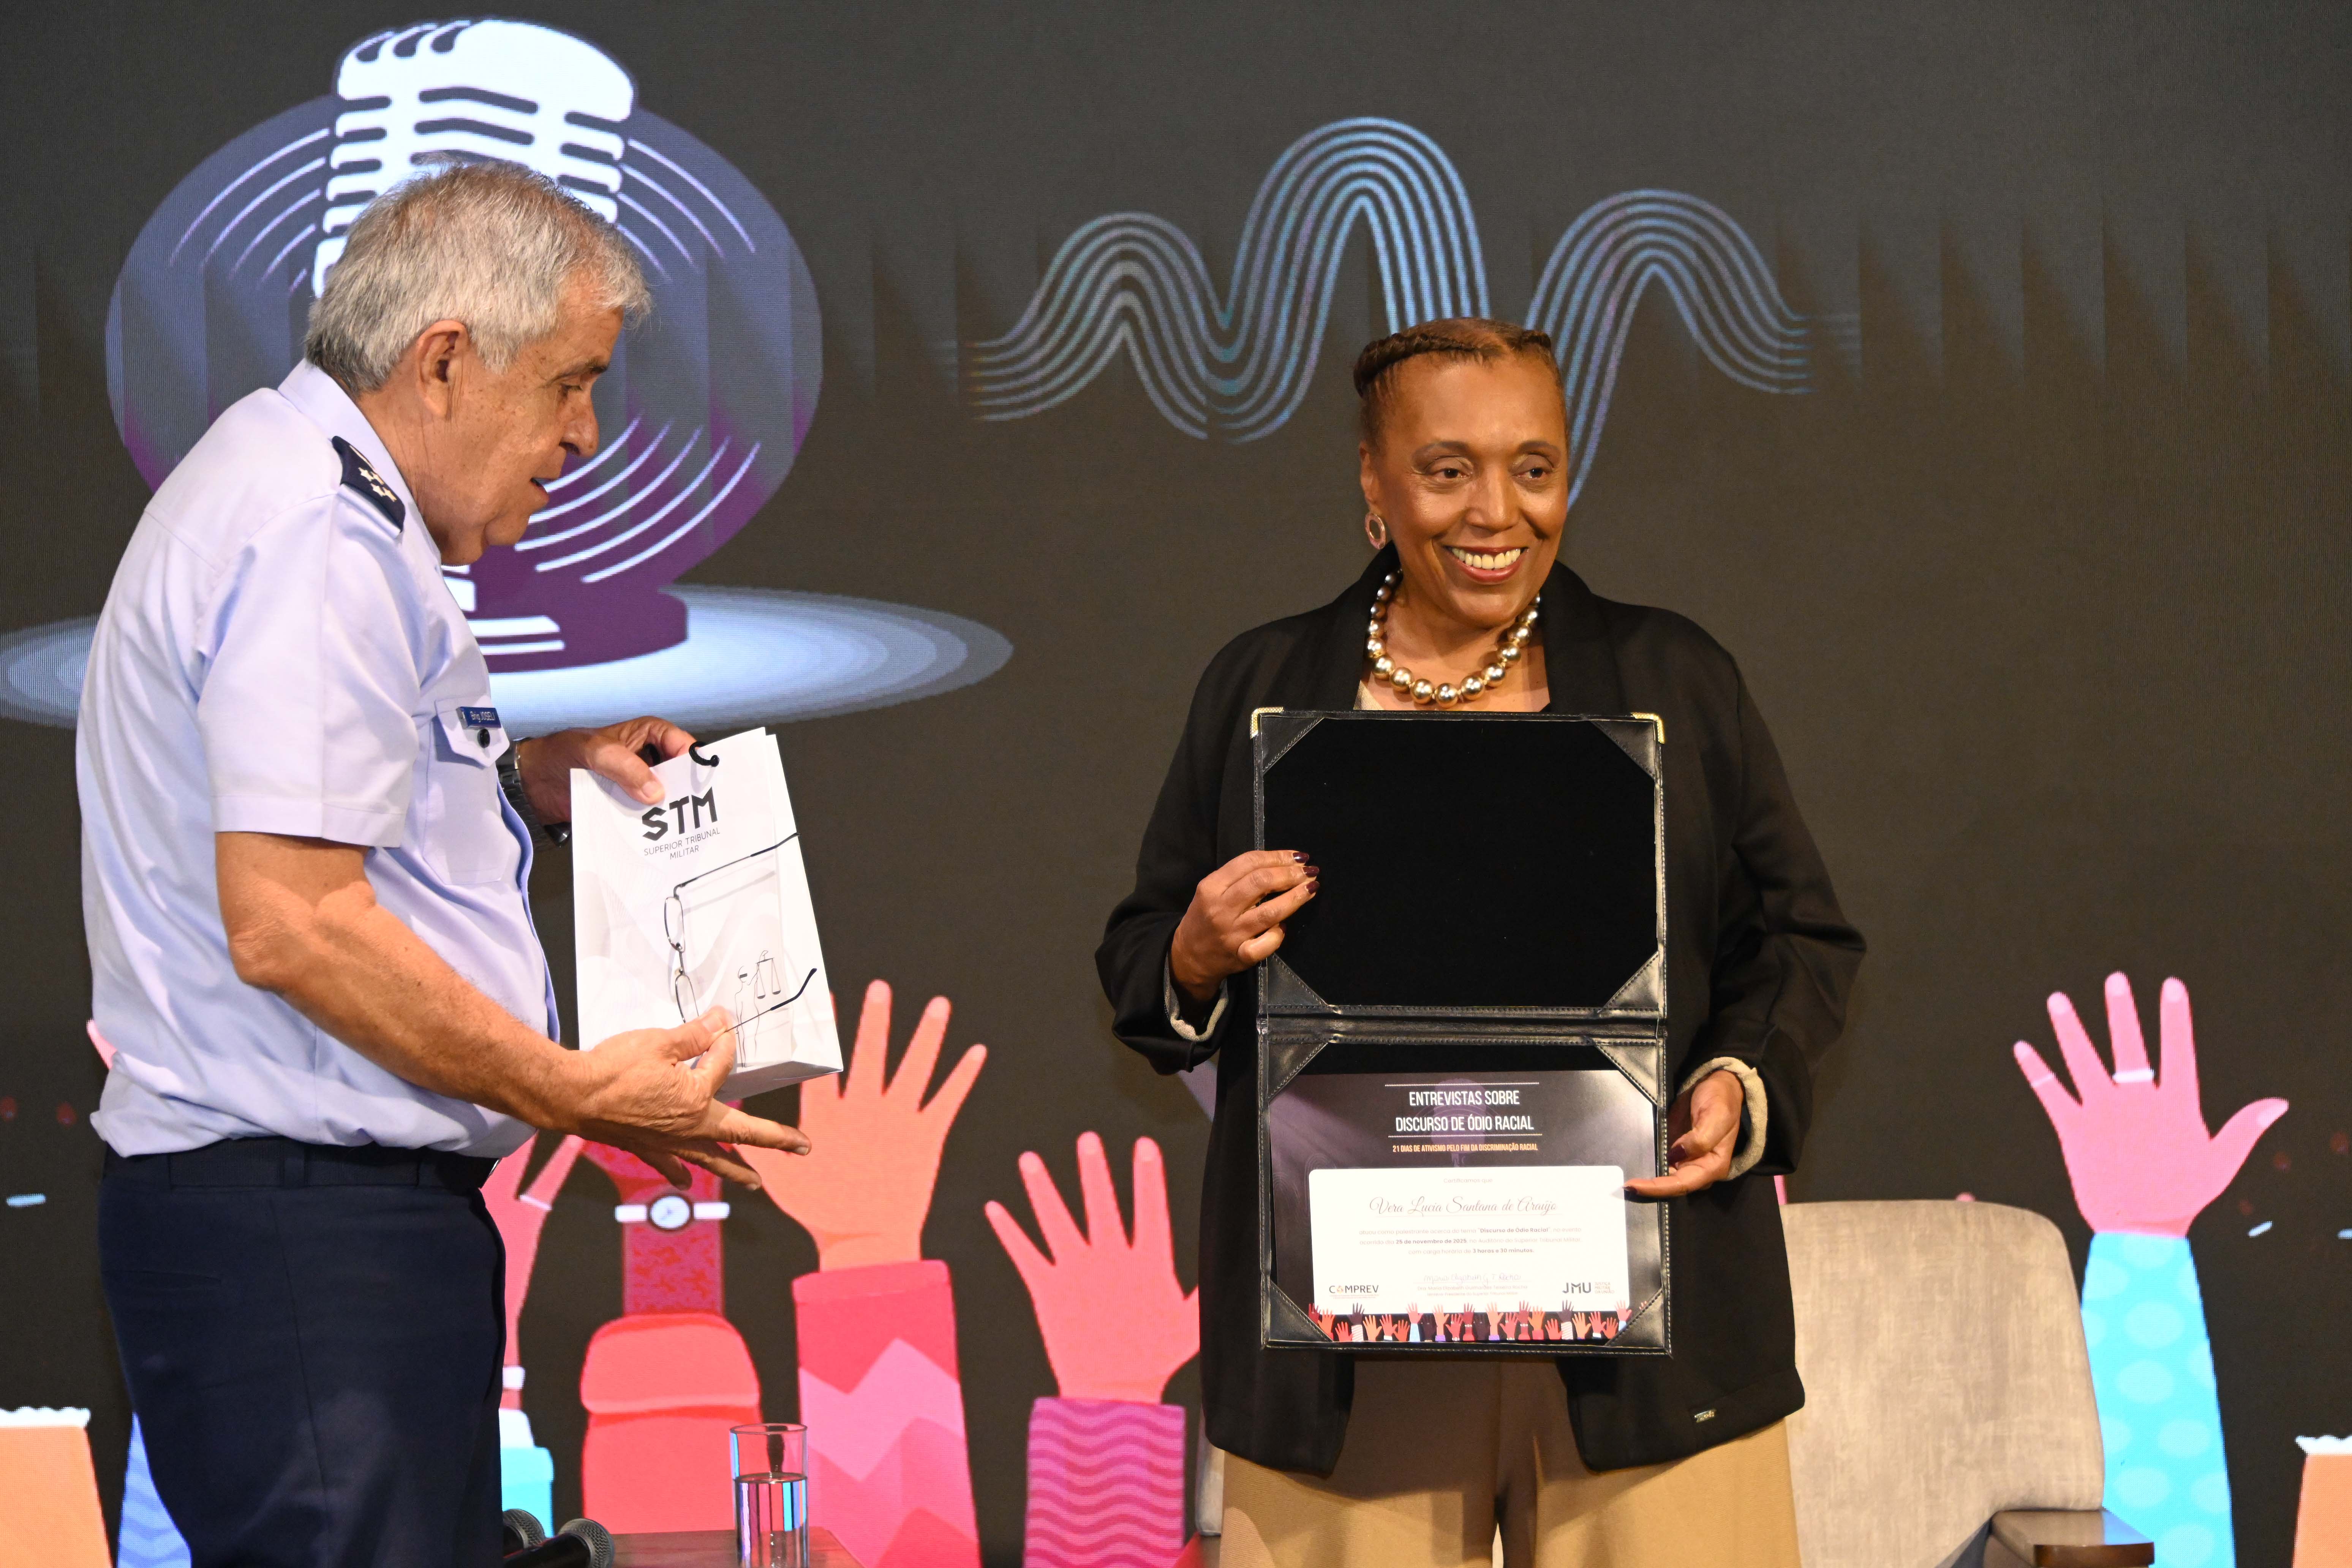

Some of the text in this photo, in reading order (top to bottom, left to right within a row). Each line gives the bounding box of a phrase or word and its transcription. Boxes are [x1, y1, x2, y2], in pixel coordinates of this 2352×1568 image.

[642, 787, 718, 841] STM
[644, 827, 720, 856] SUPERIOR TRIBUNAL
[670, 845, 699, 860] MILITAR
[1409, 1090, 1520, 1106] ENTREVISTAS SOBRE
[1396, 1114, 1534, 1132] DISCURSO DE ÓDIO RACIAL
[1479, 1143, 1519, 1152] DISCRIMINAÇÃO
[1370, 1196, 1557, 1217] Vera Lucia Santana de Araújo
[1562, 1282, 1591, 1294] JMU
